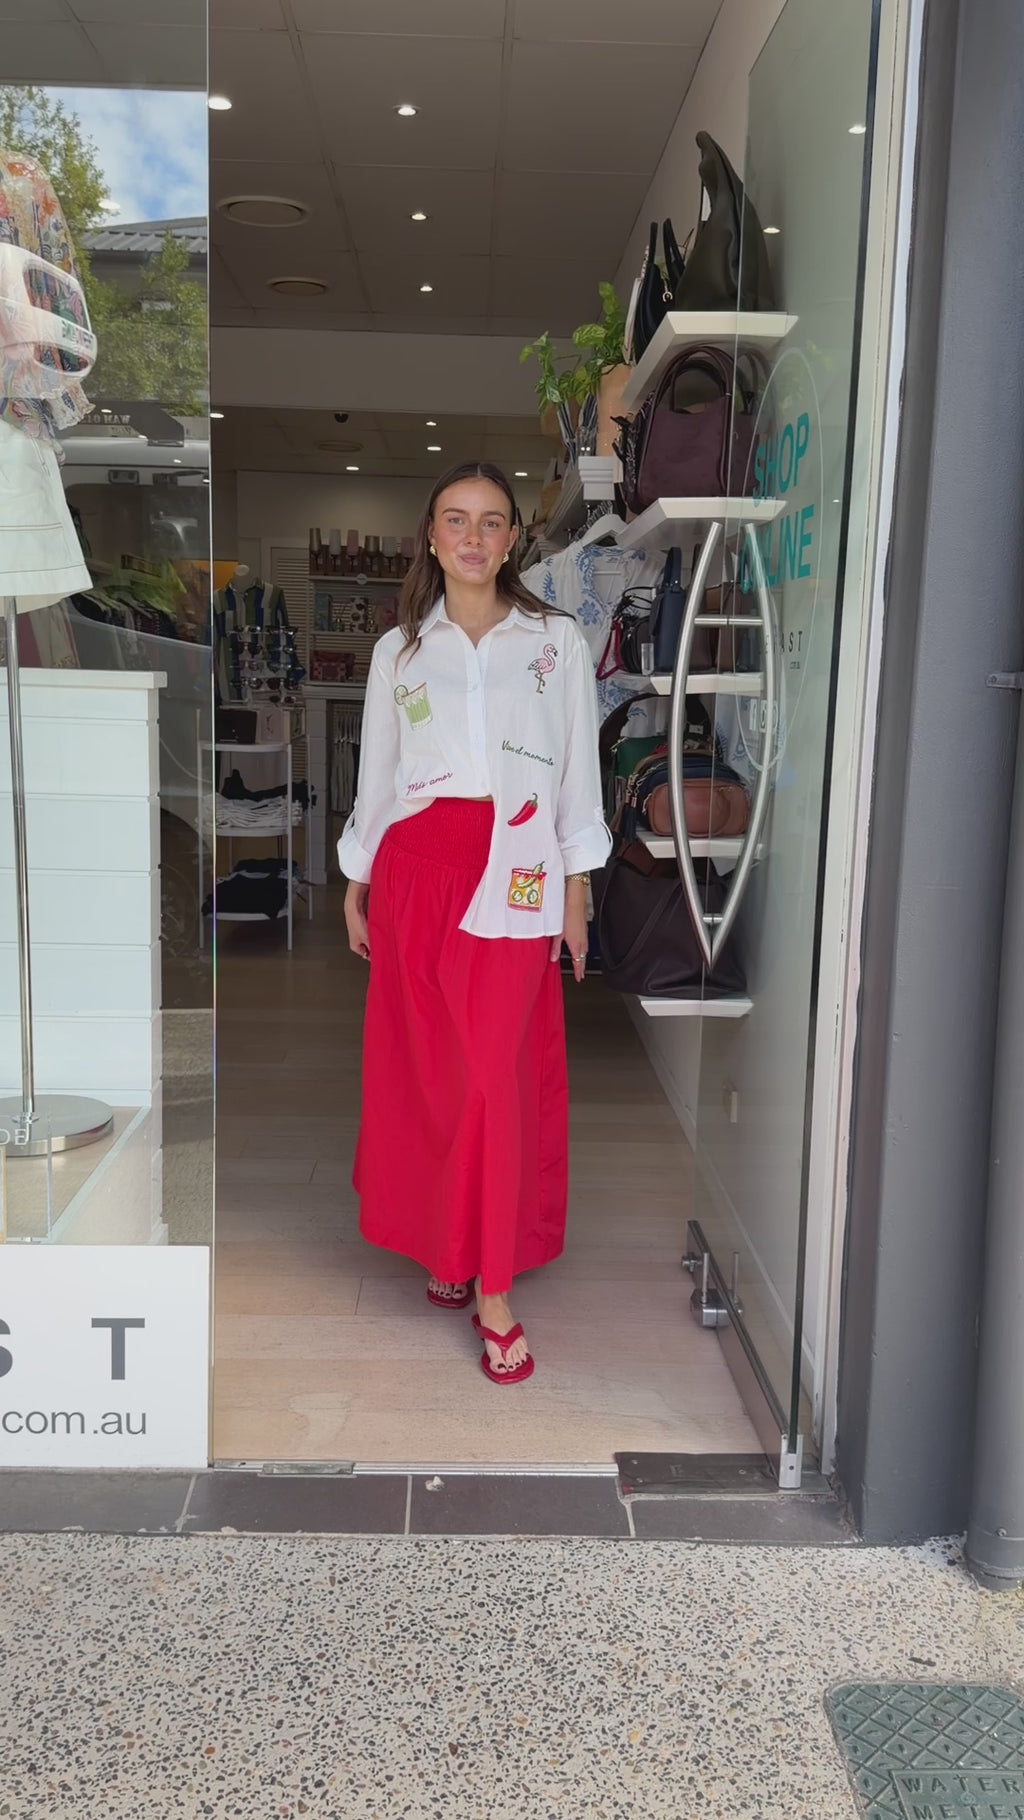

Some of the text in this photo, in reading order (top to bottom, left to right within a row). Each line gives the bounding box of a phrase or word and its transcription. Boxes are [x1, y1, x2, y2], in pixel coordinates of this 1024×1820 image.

[753, 413, 809, 507] SHOP
[429, 772, 453, 785] amor
[901, 1775, 1022, 1794] WATER
